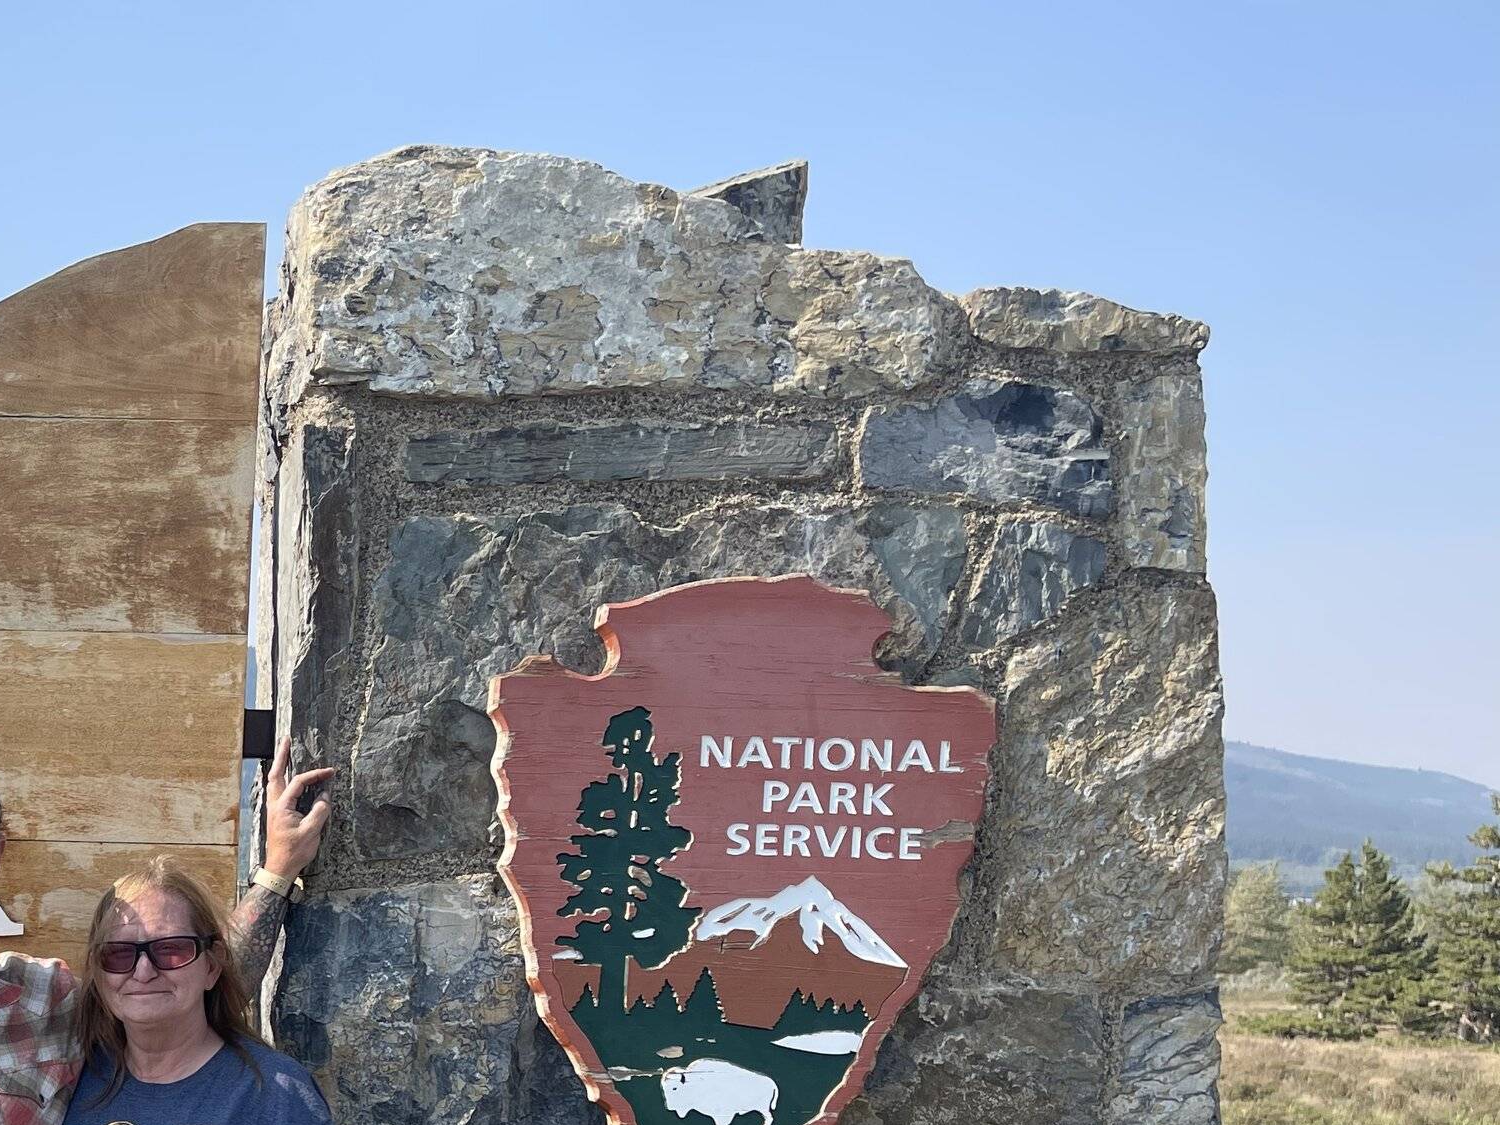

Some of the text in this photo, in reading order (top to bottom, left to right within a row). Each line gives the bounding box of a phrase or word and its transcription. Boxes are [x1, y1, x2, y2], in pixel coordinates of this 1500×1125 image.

[699, 735, 965, 774] NATIONAL
[762, 780, 896, 816] PARK
[725, 823, 925, 860] SERVICE
